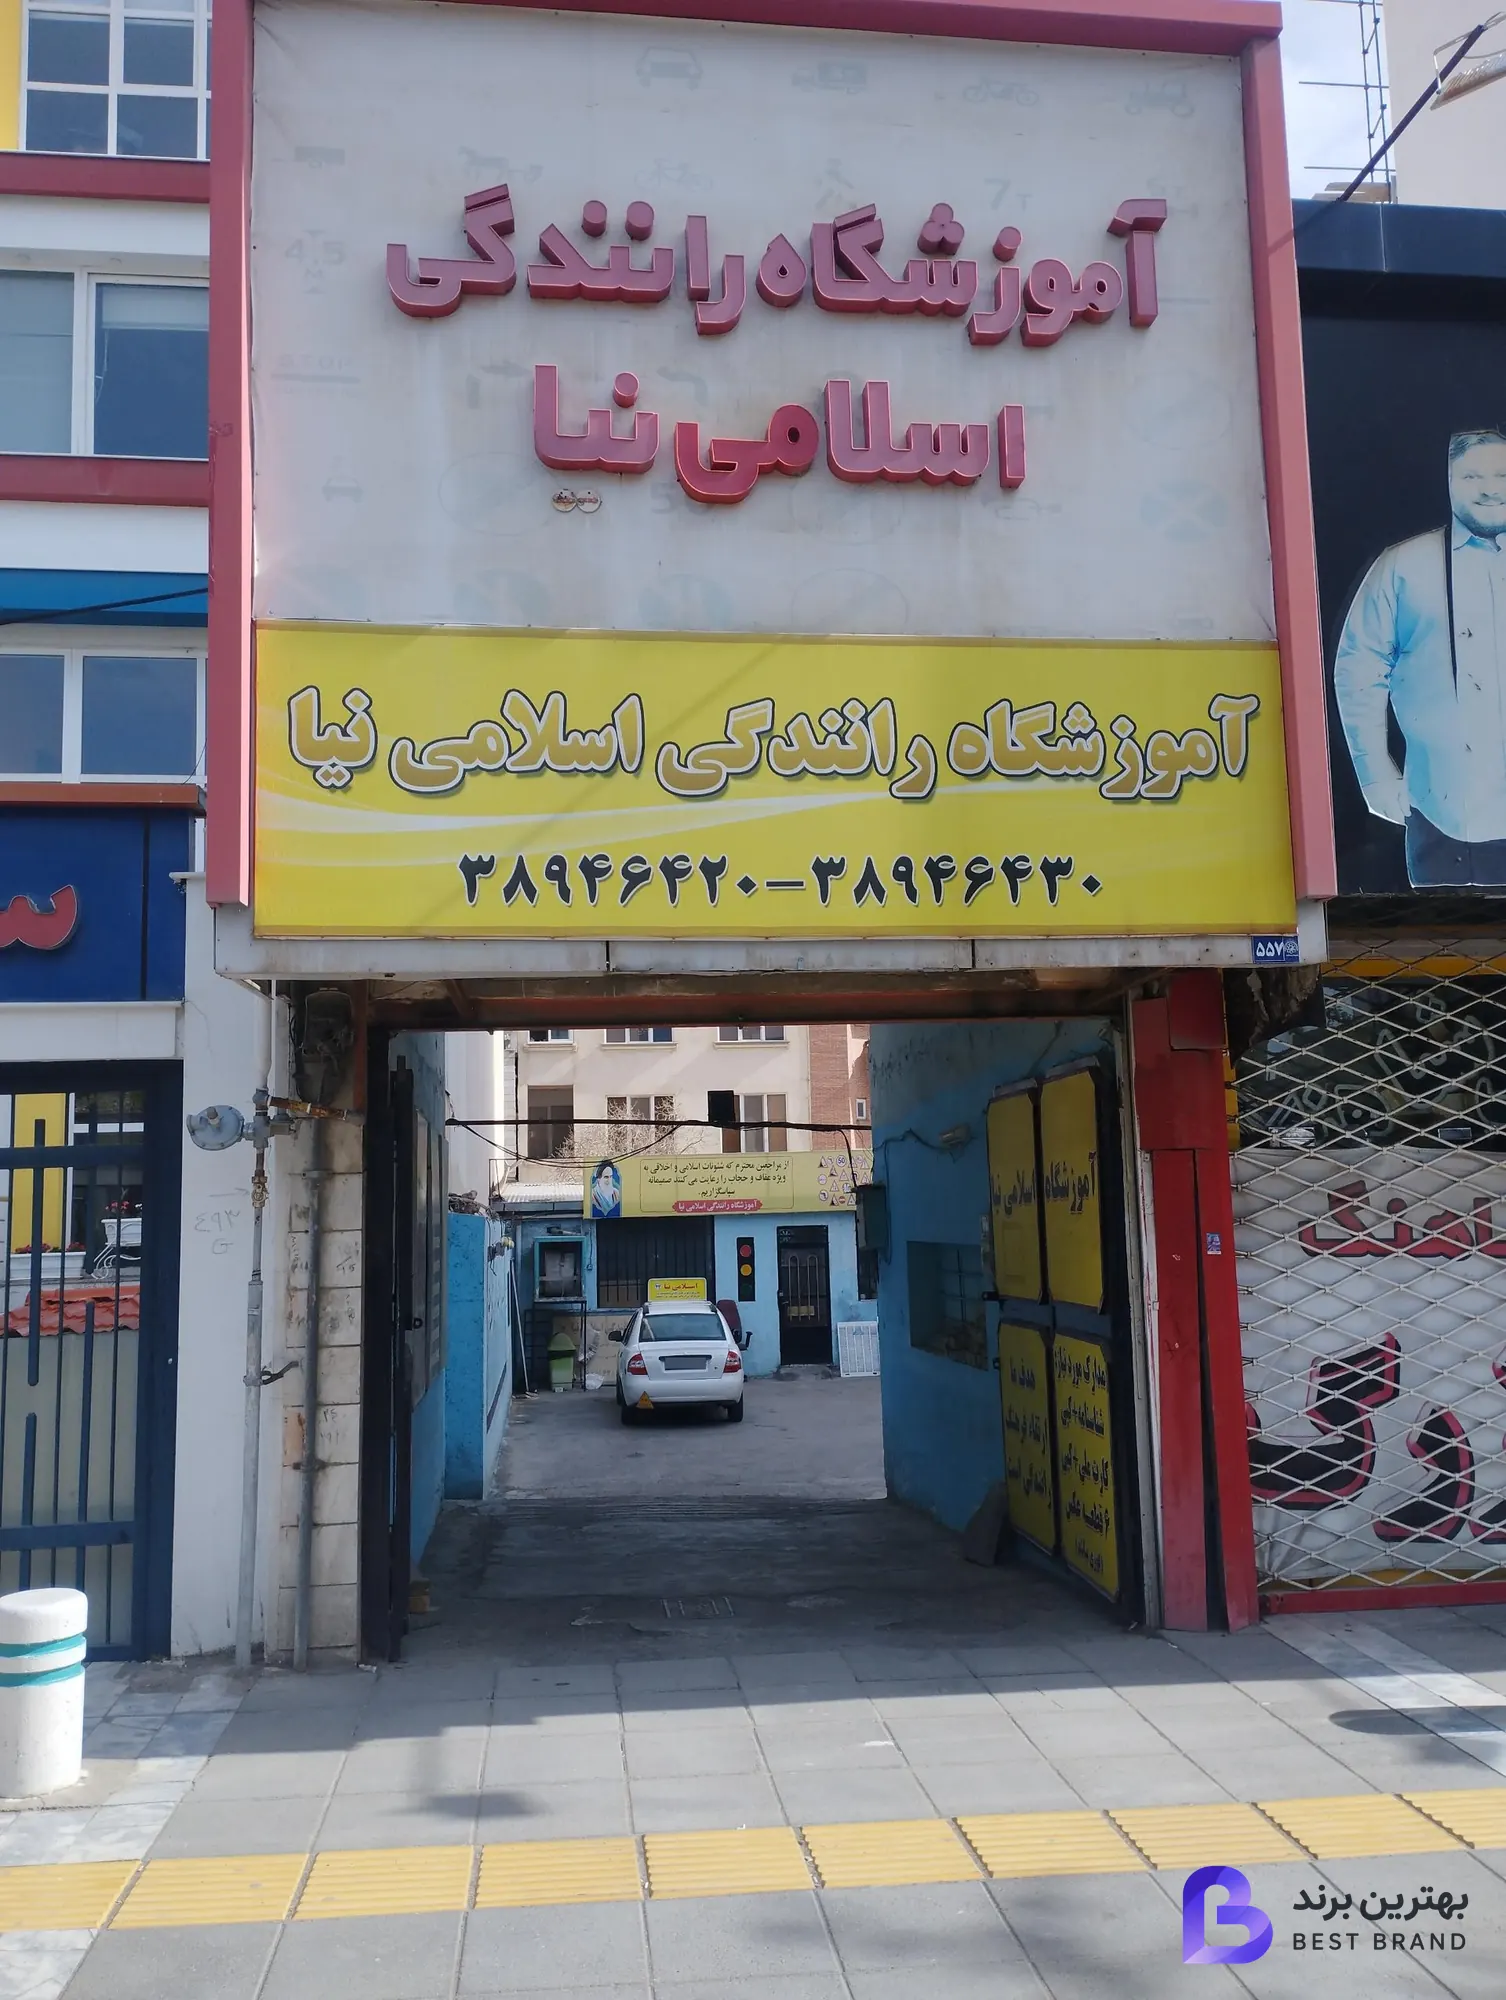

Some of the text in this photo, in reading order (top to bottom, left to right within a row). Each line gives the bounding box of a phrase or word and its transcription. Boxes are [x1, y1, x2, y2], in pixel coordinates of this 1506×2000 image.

[386, 183, 1168, 348] آموزشگاه رانندگی
[533, 363, 1027, 505] اسلامی نیا
[288, 685, 1260, 799] آموزشگاه رانندگی اسلامی نیا
[1256, 941, 1284, 957] ۵۵۷
[674, 1165, 678, 1173] و
[680, 1162, 701, 1174] اسلامی
[736, 1162, 754, 1173] محترم
[728, 1174, 748, 1185] حجاب
[750, 1176, 753, 1184] و
[1045, 1150, 1097, 1214] آموزشگاه
[686, 1202, 706, 1212] اسلامی
[707, 1201, 729, 1212] رانندگی
[731, 1200, 757, 1210] آموزشگاه
[1298, 1180, 1506, 1262] اهنگ
